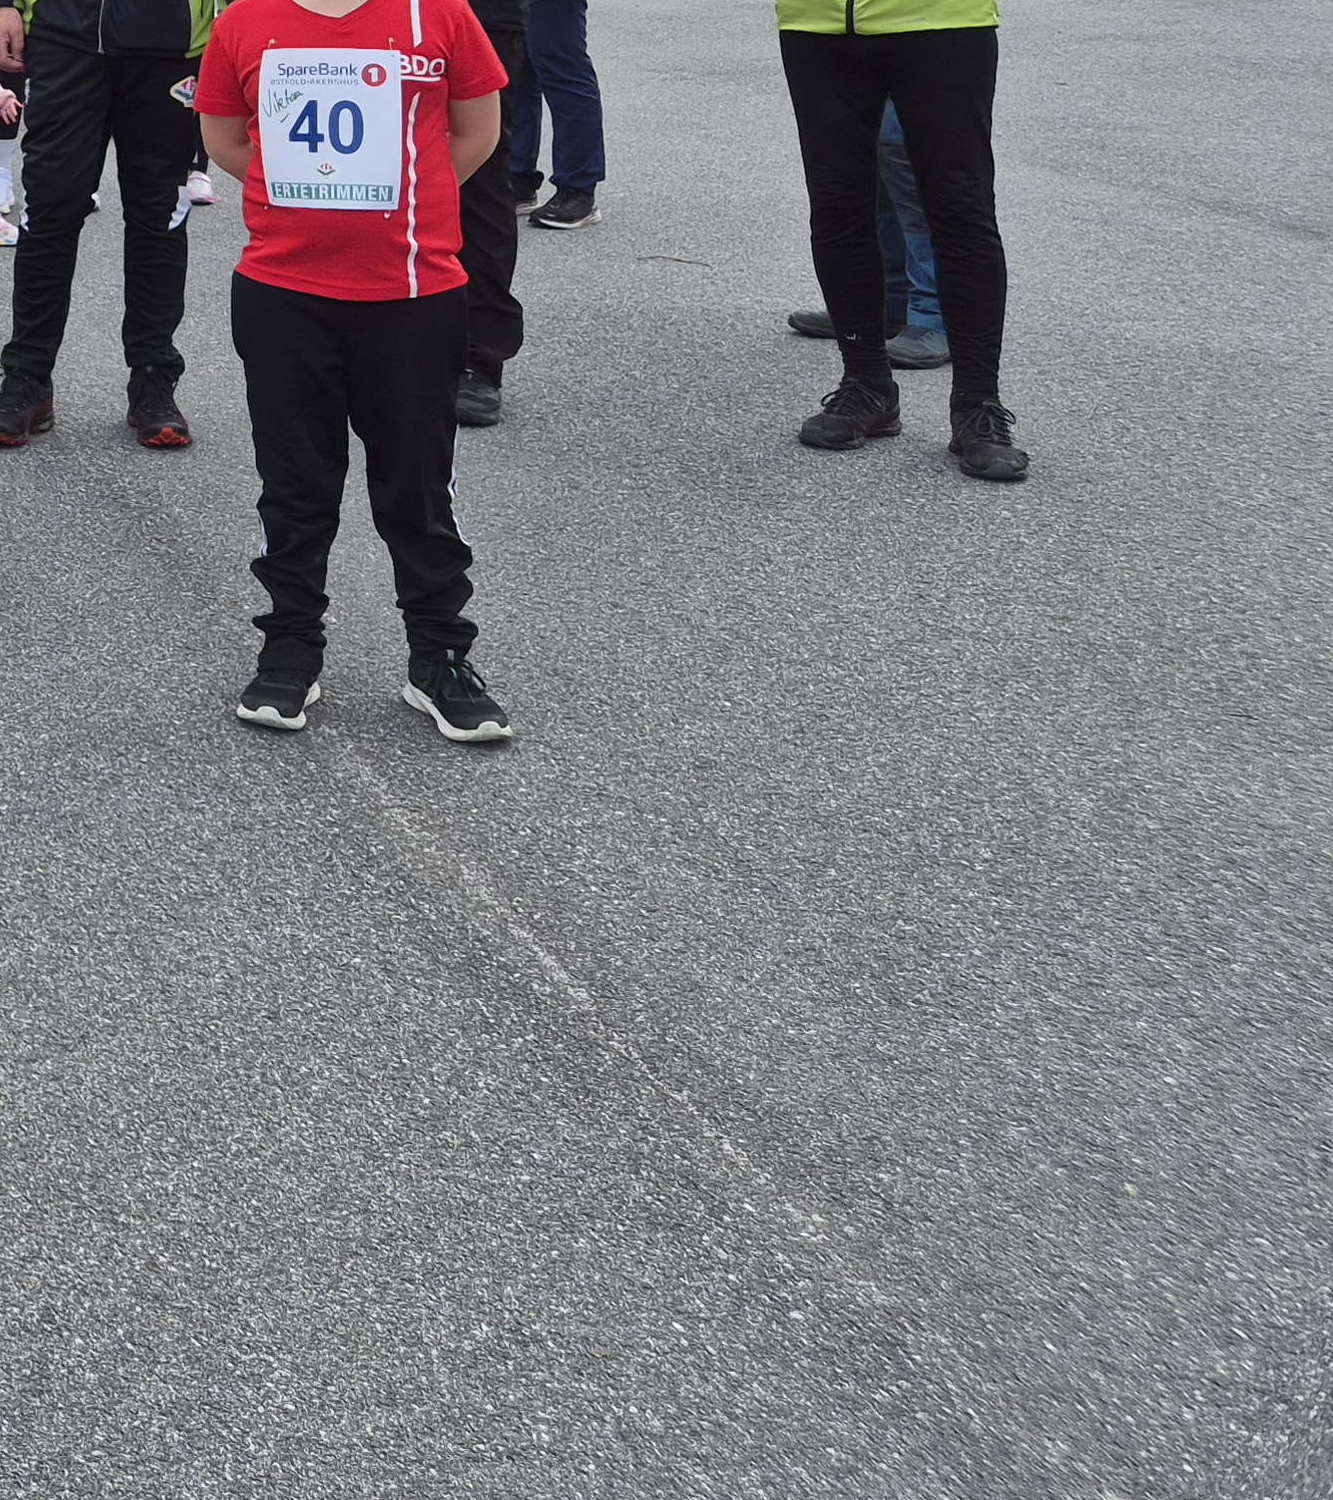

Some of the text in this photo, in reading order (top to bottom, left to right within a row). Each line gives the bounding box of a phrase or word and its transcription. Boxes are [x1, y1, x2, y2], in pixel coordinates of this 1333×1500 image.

[277, 63, 357, 78] SpareBank
[289, 100, 364, 154] 40
[274, 184, 389, 200] ERTETRIMMEN
